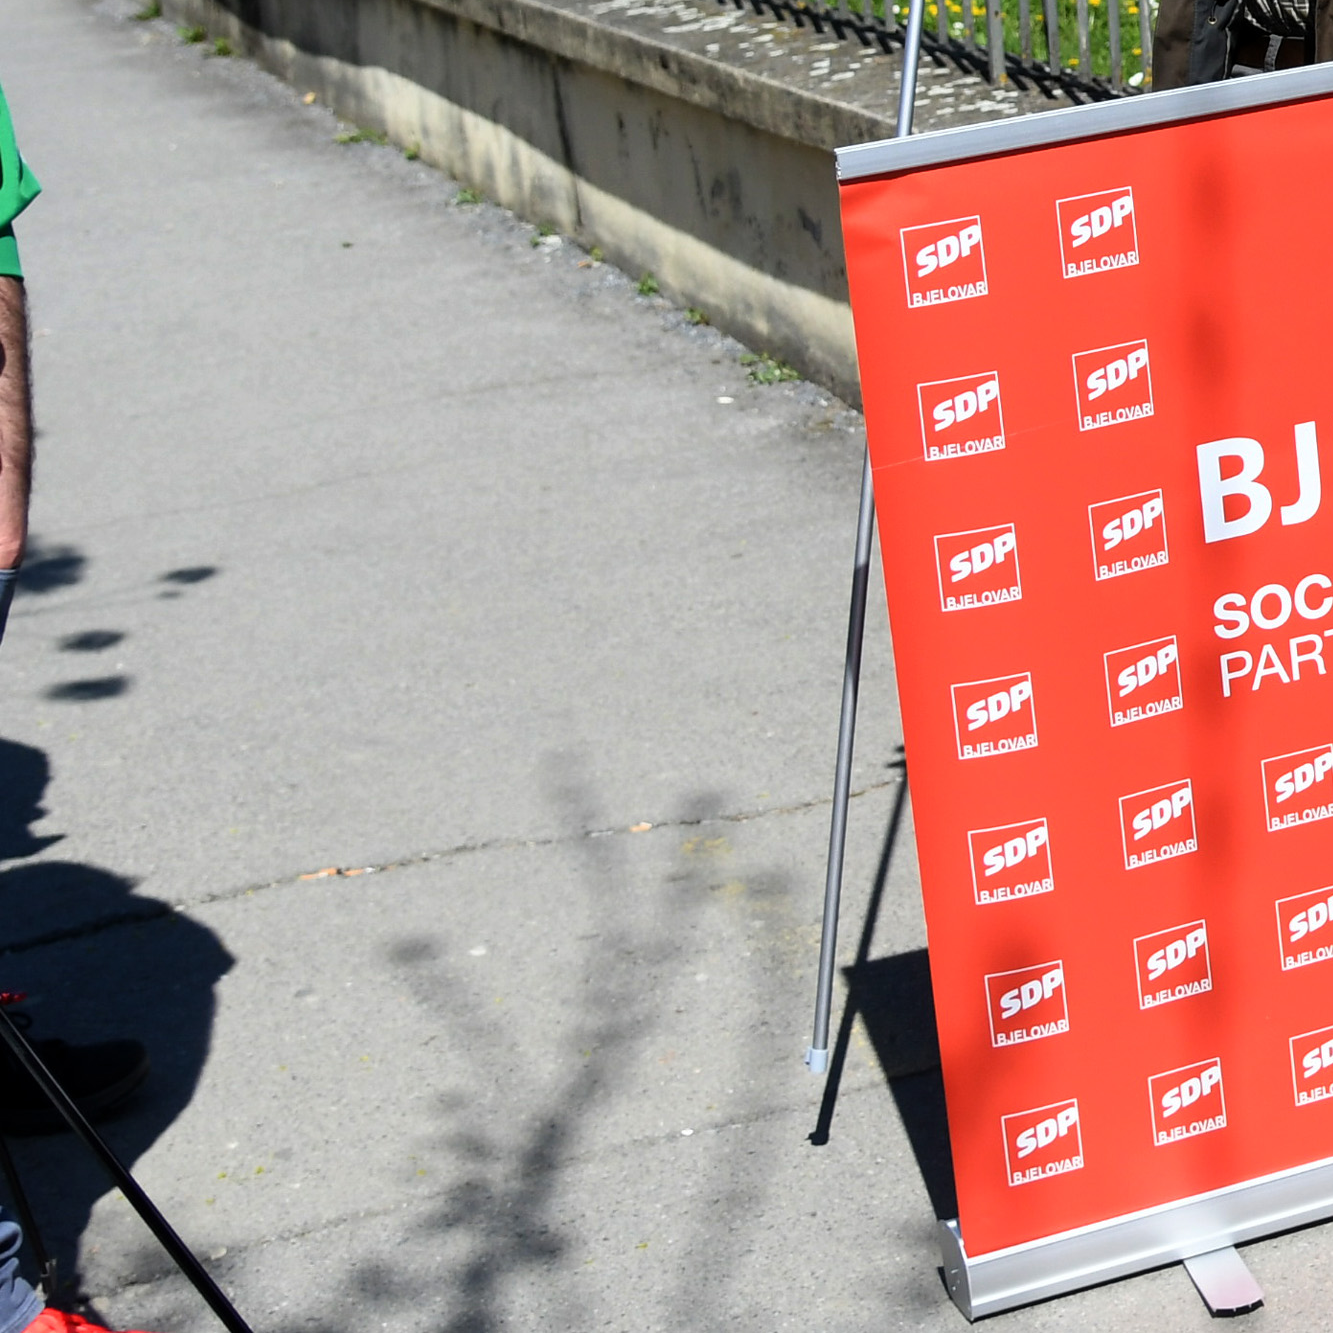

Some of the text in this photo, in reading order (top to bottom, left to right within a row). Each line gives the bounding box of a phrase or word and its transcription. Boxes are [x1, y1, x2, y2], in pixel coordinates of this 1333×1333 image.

[1070, 194, 1132, 249] SDP
[915, 223, 980, 277] SDP
[1067, 250, 1137, 277] BJELOVAR
[911, 279, 986, 306] BJELOVAR
[1086, 347, 1148, 401] SDP
[932, 379, 998, 432] SDP
[1083, 401, 1152, 429] BJELOVAR
[928, 435, 1003, 459] BJELOVAR
[1103, 497, 1163, 551] SDP
[949, 531, 1015, 583] SDP
[1099, 549, 1167, 579] BJELOVAR
[945, 585, 1020, 610] BJELOVAR
[1117, 643, 1177, 698] SDP
[966, 680, 1031, 731] SDP
[1114, 695, 1181, 725] BJELOVAR
[962, 733, 1036, 758] BJELOVAR
[1275, 751, 1333, 803] SDP
[1132, 787, 1191, 840] SDP
[982, 825, 1046, 876] SDP
[1128, 837, 1196, 867] BJELOVAR
[979, 877, 1052, 903] BJELOVAR
[1147, 927, 1205, 981] SDP
[999, 968, 1063, 1019] SDP
[1143, 976, 1210, 1008] BJELOVAR
[996, 1018, 1067, 1045] BJELOVAR
[1161, 1065, 1220, 1118] SDP
[1016, 1106, 1077, 1158] SDP
[1157, 1114, 1225, 1144] BJELOVAR
[1012, 1155, 1082, 1184] BJELOVAR
